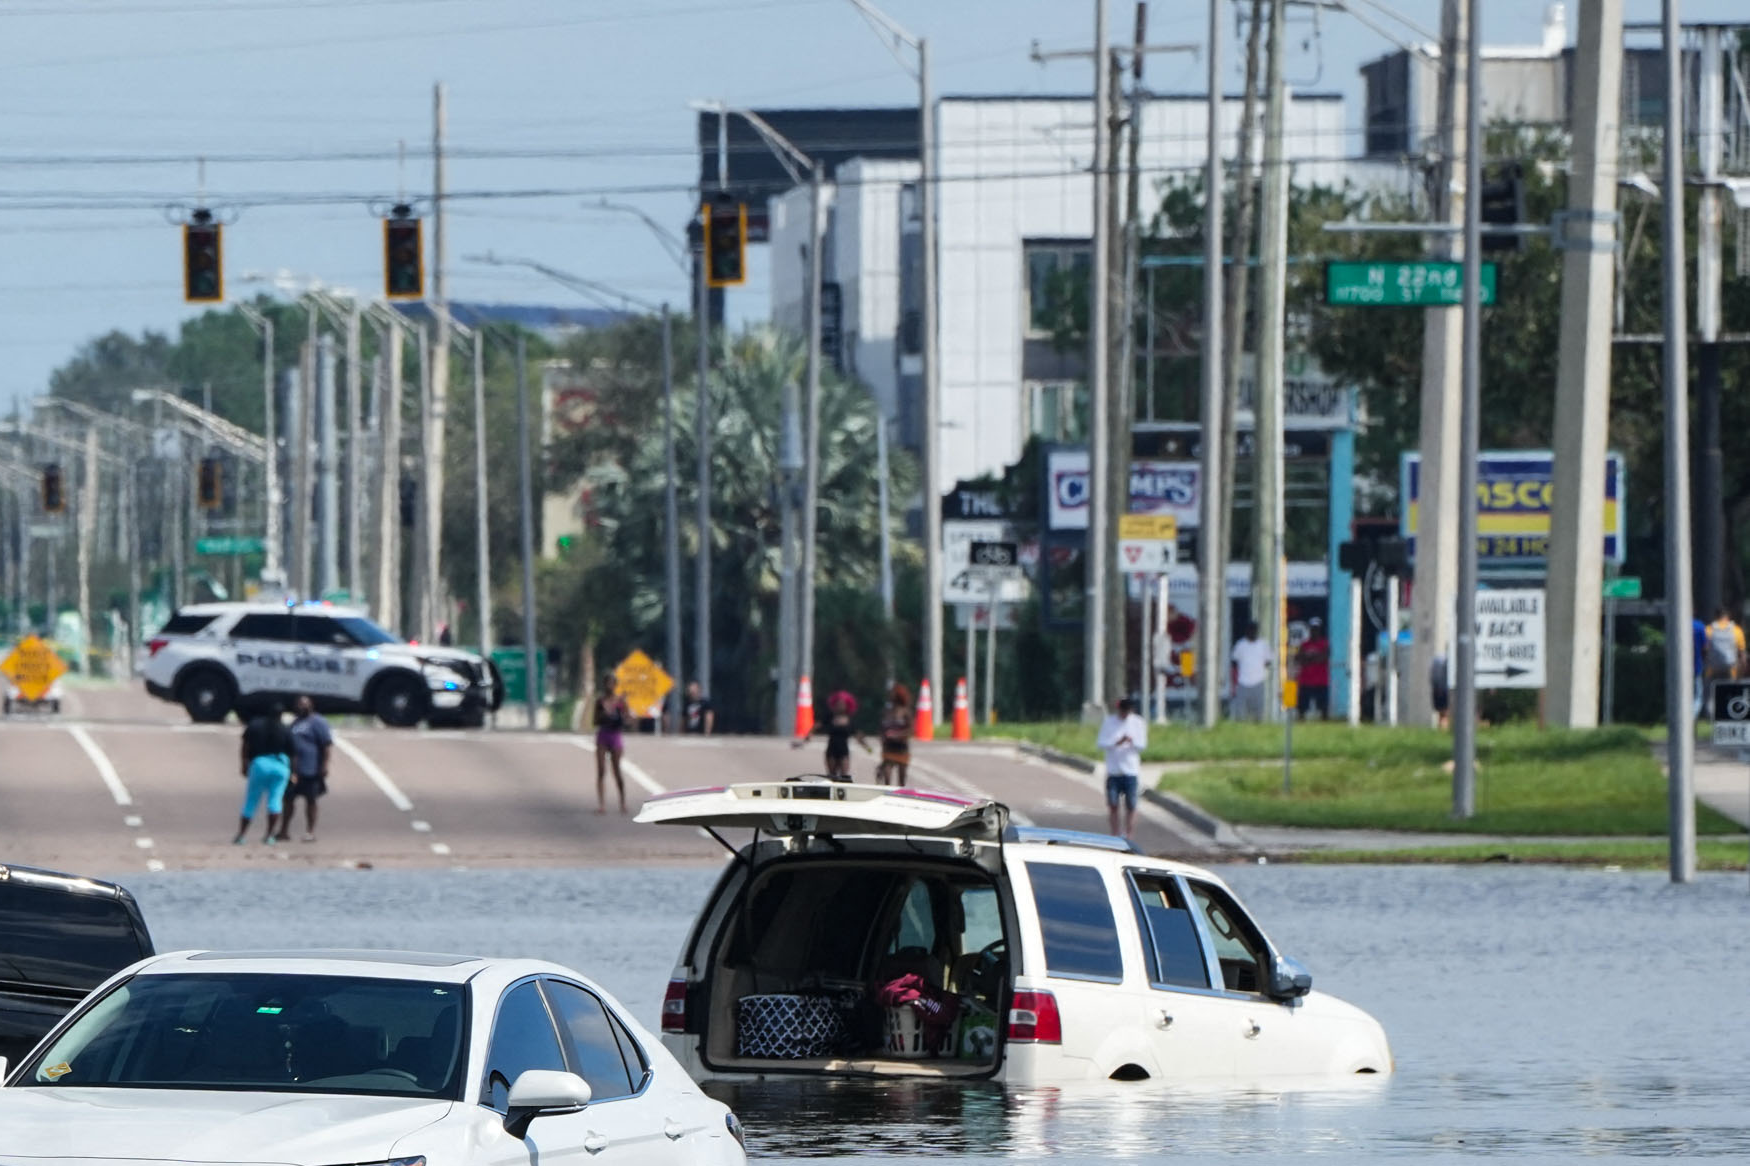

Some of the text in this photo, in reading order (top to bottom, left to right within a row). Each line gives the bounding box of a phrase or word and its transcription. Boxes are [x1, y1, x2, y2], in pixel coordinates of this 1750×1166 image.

[1367, 265, 1458, 287] N 22nd
[1059, 472, 1195, 505] CMPS
[1476, 597, 1538, 614] AVAILABLE
[1487, 621, 1525, 637] BACK
[237, 652, 341, 674] POLICE
